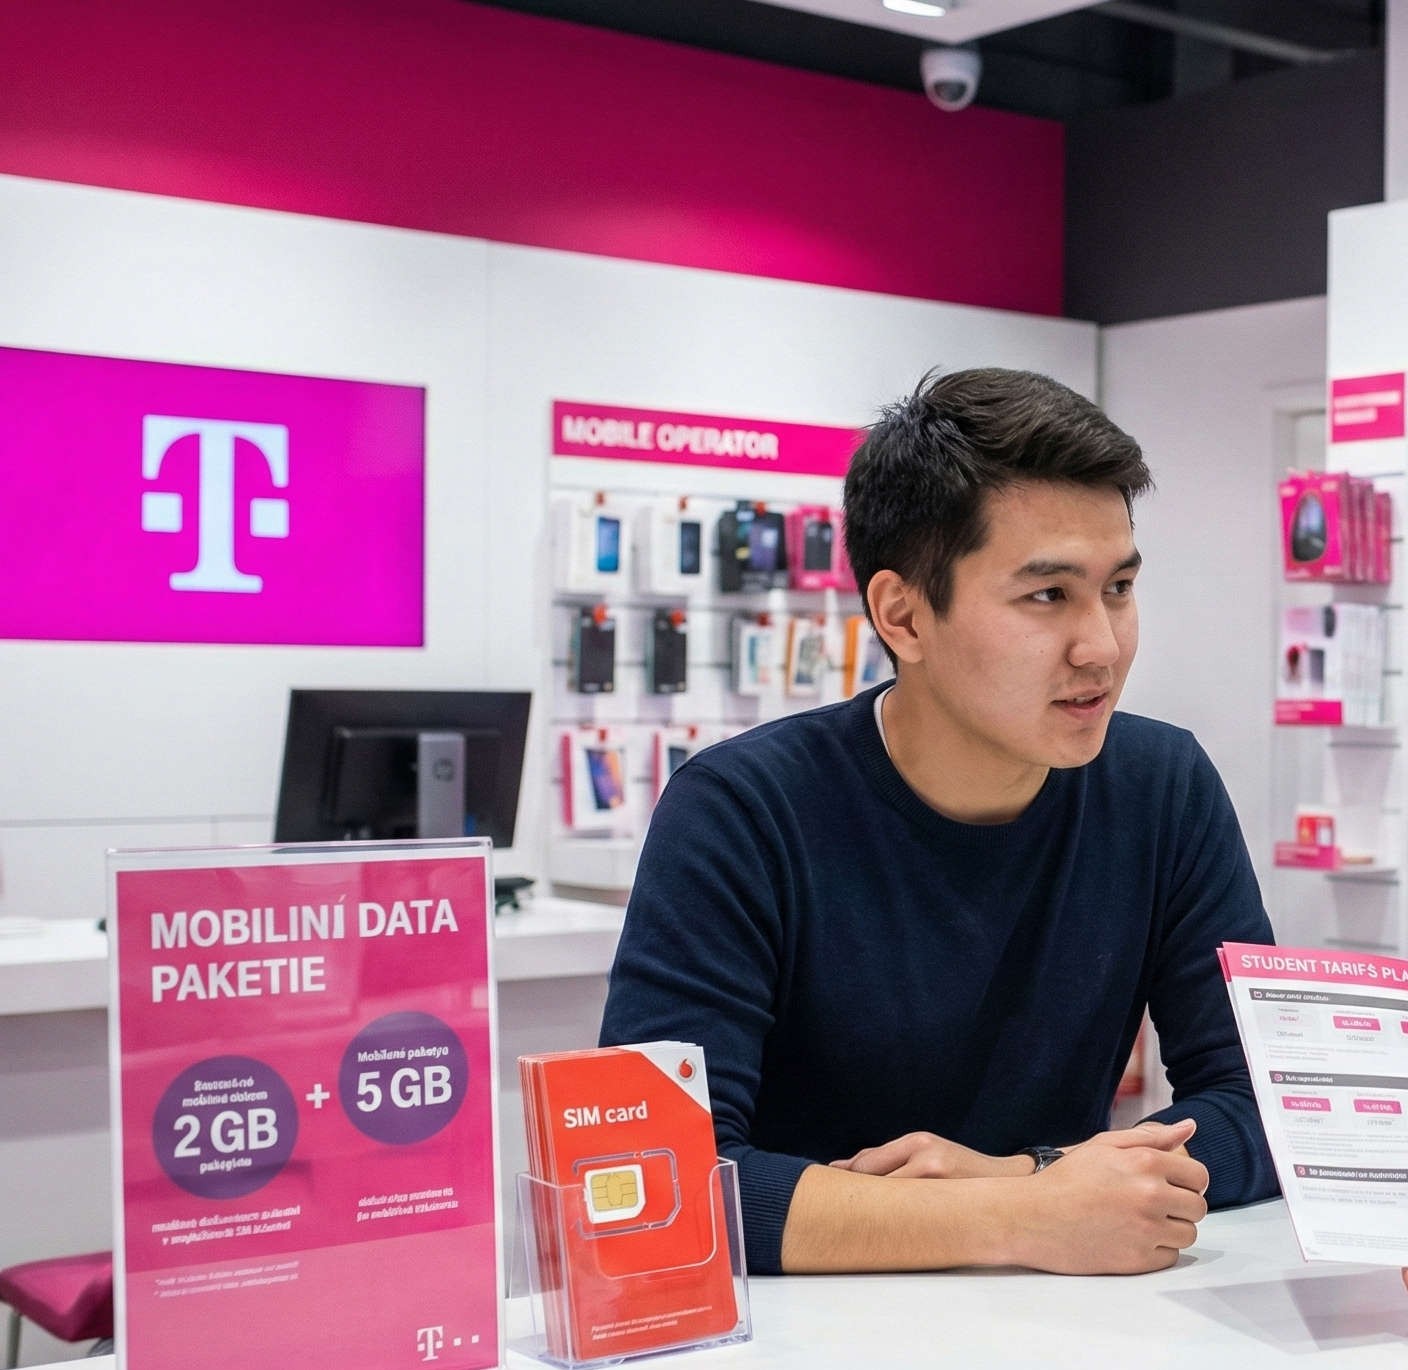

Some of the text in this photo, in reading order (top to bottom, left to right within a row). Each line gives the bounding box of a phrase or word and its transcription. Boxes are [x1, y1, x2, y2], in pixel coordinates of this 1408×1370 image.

[562, 415, 779, 460] MOBILE OPERATOR
[150, 895, 459, 950] MOBILINÍ DATA
[151, 956, 326, 1003] PAKETIE
[1240, 954, 1317, 974] STUDENT
[356, 1065, 452, 1112] 5 GB
[173, 1107, 278, 1158] 2 GB
[563, 1100, 648, 1129] SIM card
